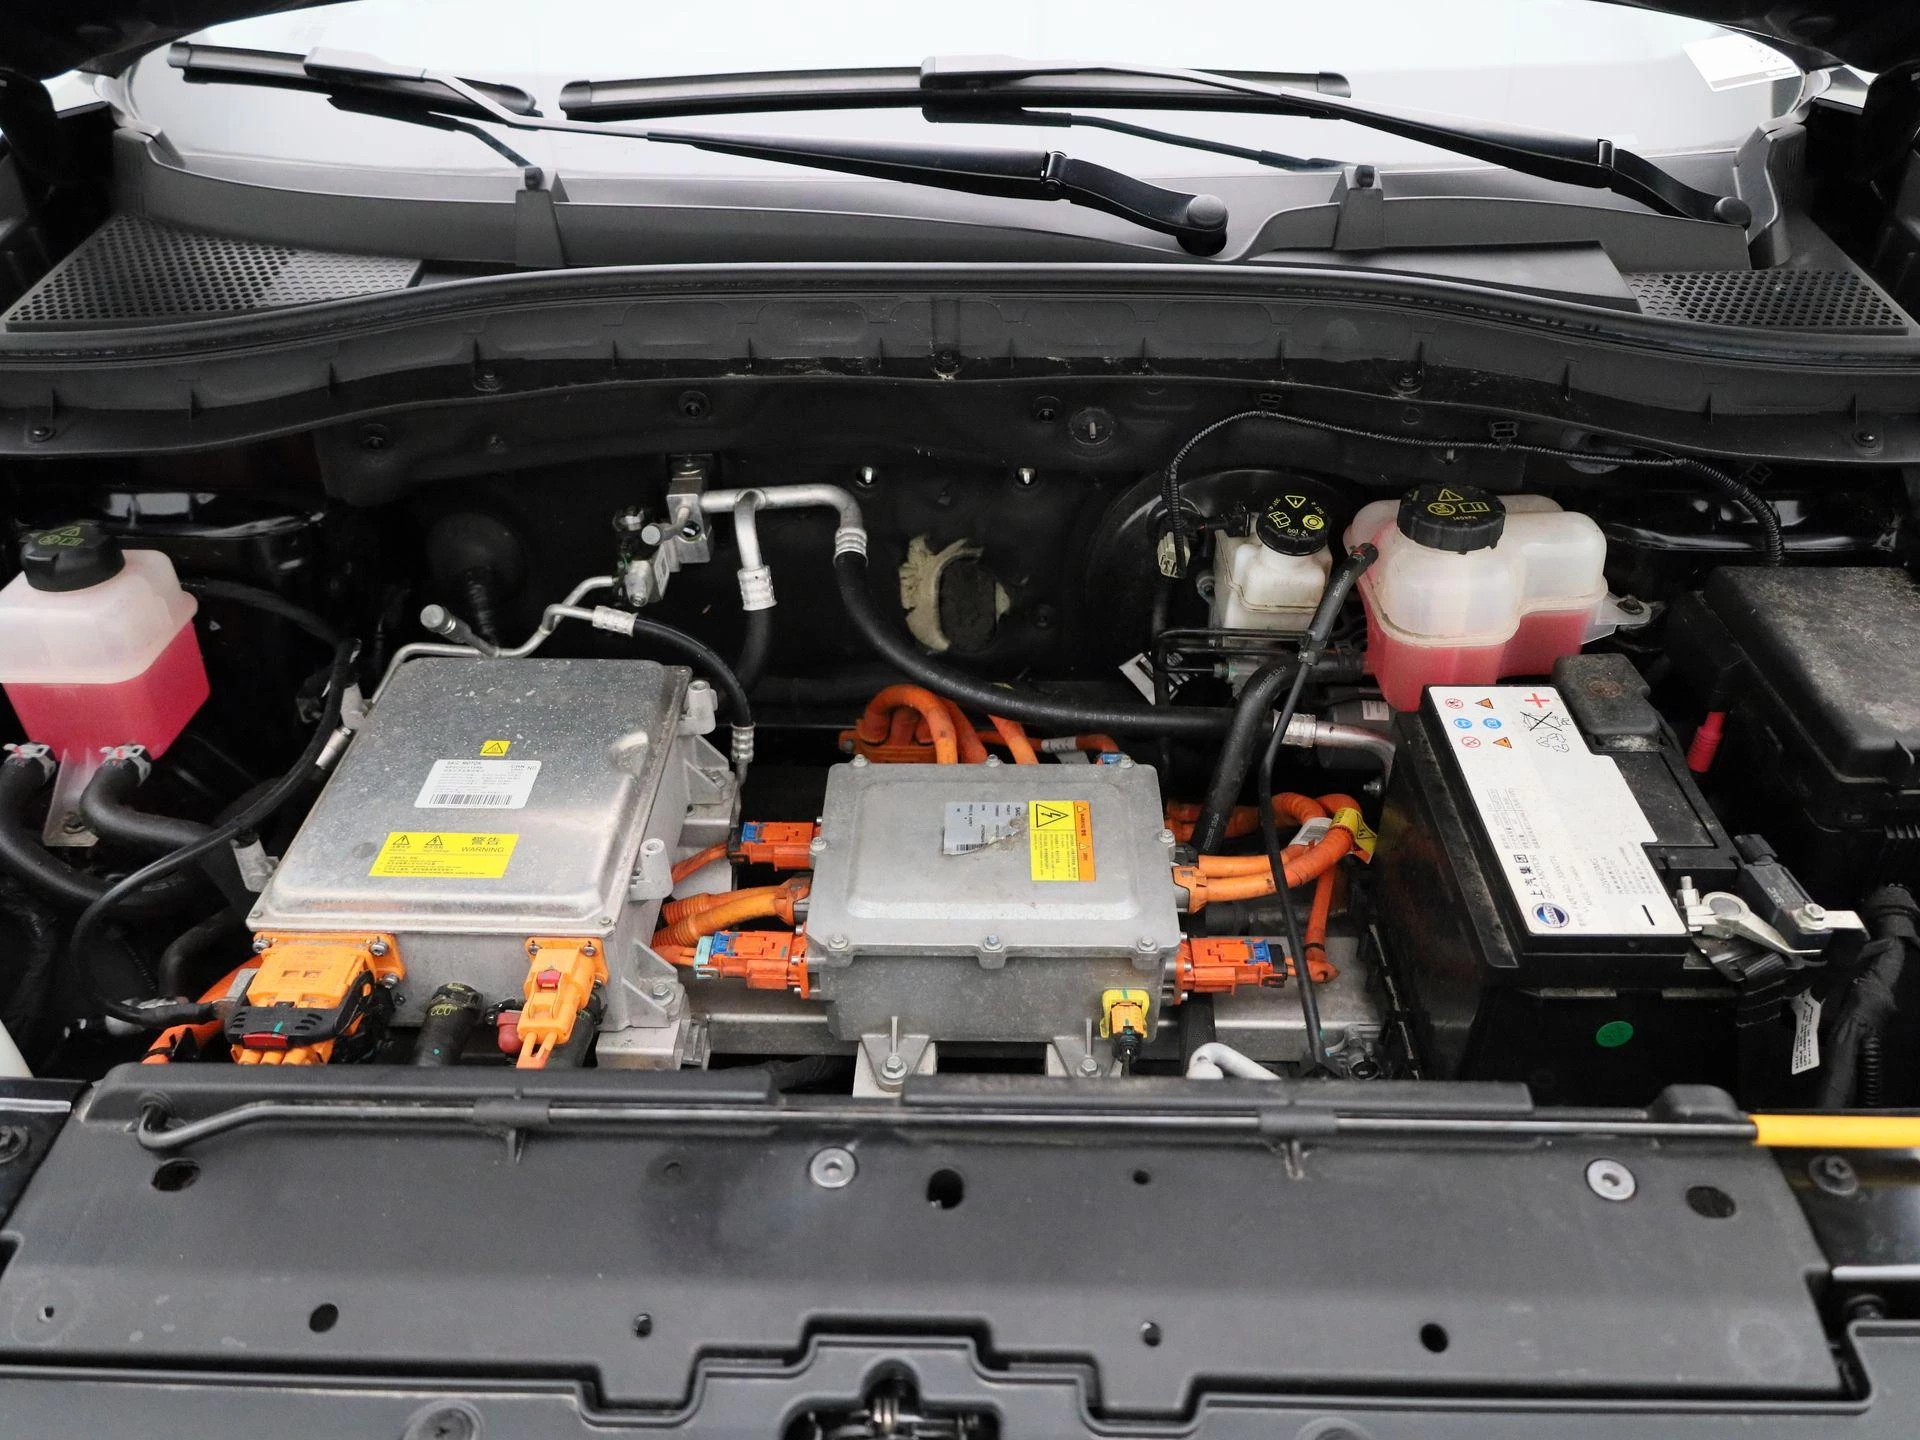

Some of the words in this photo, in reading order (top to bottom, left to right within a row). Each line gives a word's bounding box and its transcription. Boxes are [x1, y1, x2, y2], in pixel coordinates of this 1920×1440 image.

[1513, 854, 1545, 898] 上汽集团
[1544, 904, 1558, 925] SAIC
